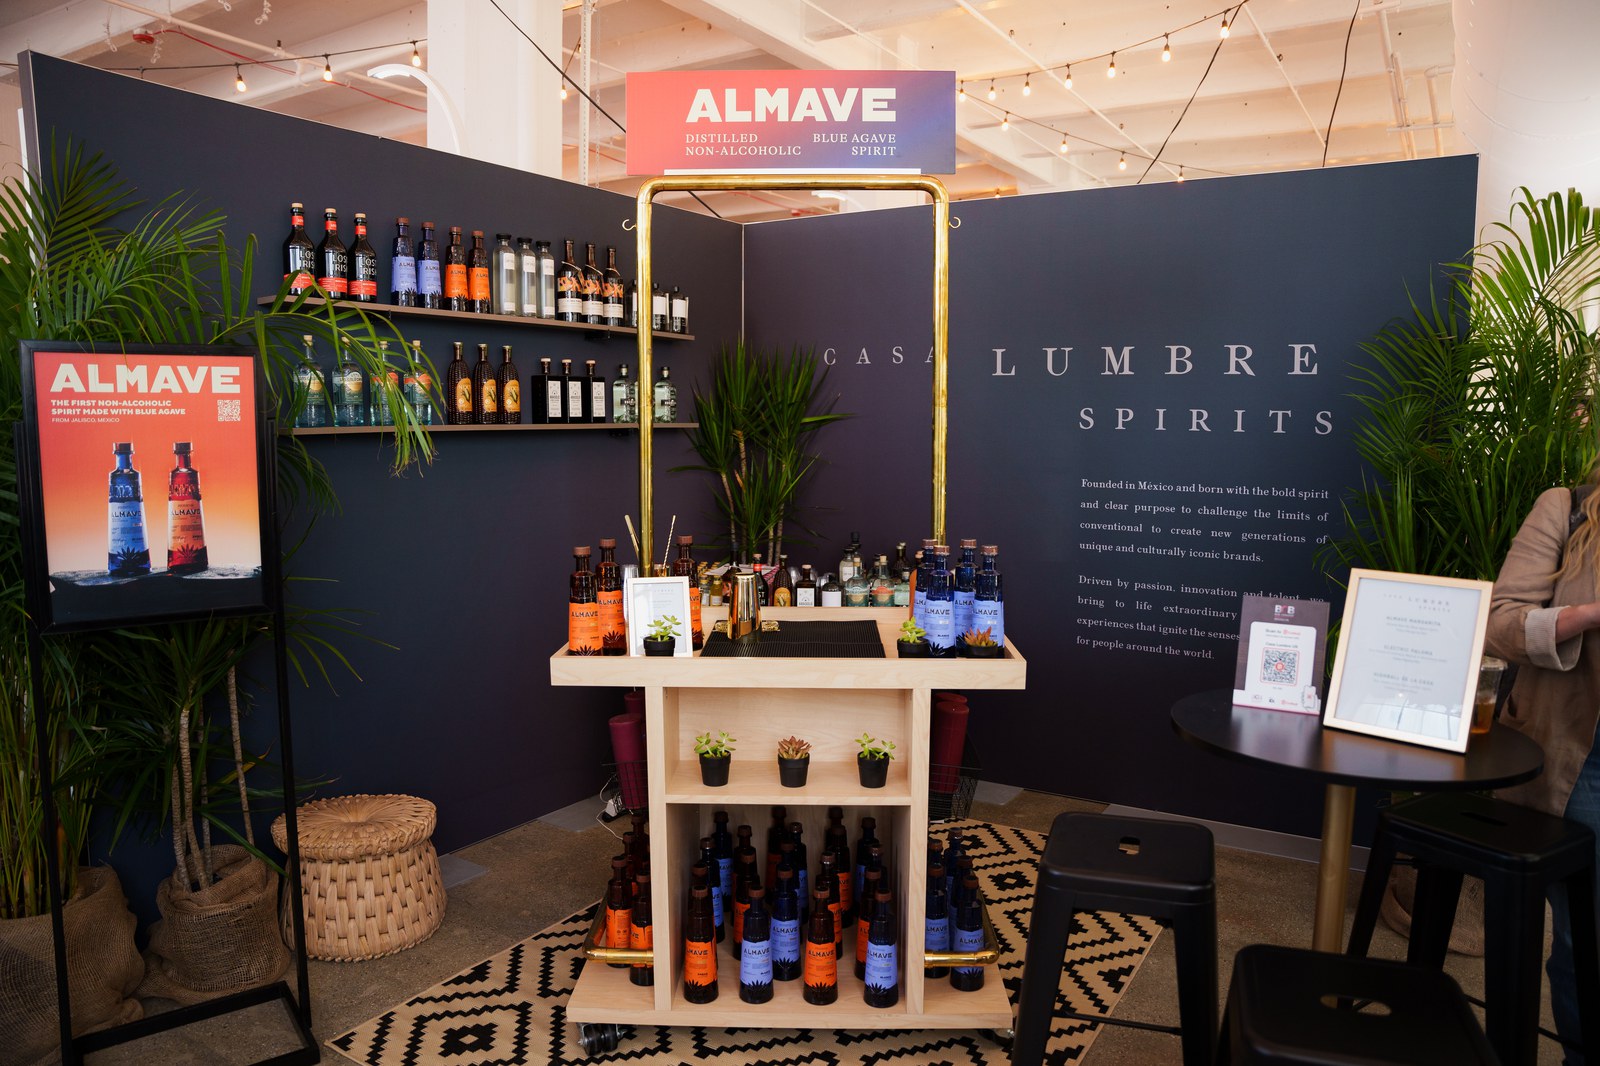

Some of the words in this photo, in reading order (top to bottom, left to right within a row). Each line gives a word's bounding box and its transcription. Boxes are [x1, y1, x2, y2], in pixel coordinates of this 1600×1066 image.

[685, 87, 897, 123] ALMAVE
[686, 133, 758, 144] DISTILLED
[813, 133, 848, 143] BLUE
[851, 133, 896, 143] AGAVE
[686, 145, 802, 156] NON-ALCOHOLIC
[851, 146, 897, 156] SPIRIT
[992, 343, 1319, 377] LUMBRE
[50, 363, 241, 394] ALMAVE
[50, 399, 70, 407] THE
[70, 399, 97, 407] FIRST
[135, 408, 158, 416] BLUE
[158, 408, 186, 416] AGAVE
[1079, 407, 1333, 435] SPIRITS
[1081, 479, 1123, 489] Founded
[1125, 481, 1136, 489] in
[1138, 481, 1174, 491] México
[1176, 484, 1196, 492] and
[1198, 484, 1223, 493] born
[1226, 486, 1250, 495] with
[1252, 487, 1270, 496] the
[1272, 487, 1296, 497] bold
[1298, 490, 1329, 500] spirit
[1080, 501, 1099, 509] and
[1104, 501, 1129, 510] clear
[1134, 504, 1176, 514] purpose
[1181, 506, 1192, 514] to
[1197, 506, 1248, 519] challenge
[1254, 509, 1271, 518] the
[1277, 510, 1311, 521] limits
[1317, 512, 1329, 521] of
[1080, 522, 1143, 532] conventional
[1152, 525, 1161, 533] to
[1170, 527, 1202, 536] create
[1211, 530, 1232, 538] new
[1241, 532, 1306, 543] generations
[1316, 535, 1328, 544] of
[1079, 542, 1113, 553] unique
[1115, 544, 1134, 553] and
[1137, 545, 1186, 558] culturally
[1189, 549, 1220, 559] iconic
[1223, 551, 1264, 562] brands.
[1078, 575, 1113, 586] Driven
[1117, 578, 1130, 589] by
[1180, 584, 1238, 597] innovation
[1077, 596, 1105, 608] bring
[1115, 600, 1125, 608] to
[1136, 601, 1152, 611] life
[1163, 605, 1238, 621] extraordinary
[1076, 617, 1135, 630] experiences
[1136, 622, 1156, 632] that
[1159, 624, 1188, 636] ignite
[1189, 627, 1206, 637] the
[1208, 631, 1240, 641] senses
[1076, 636, 1090, 645] for
[1092, 639, 1124, 650] people
[1126, 643, 1162, 654] around
[1165, 645, 1181, 656] the
[1183, 649, 1215, 660] world.
[687, 948, 709, 956] MAVE
[743, 947, 770, 956] ALMAVE
[808, 949, 835, 958] ALMAVE
